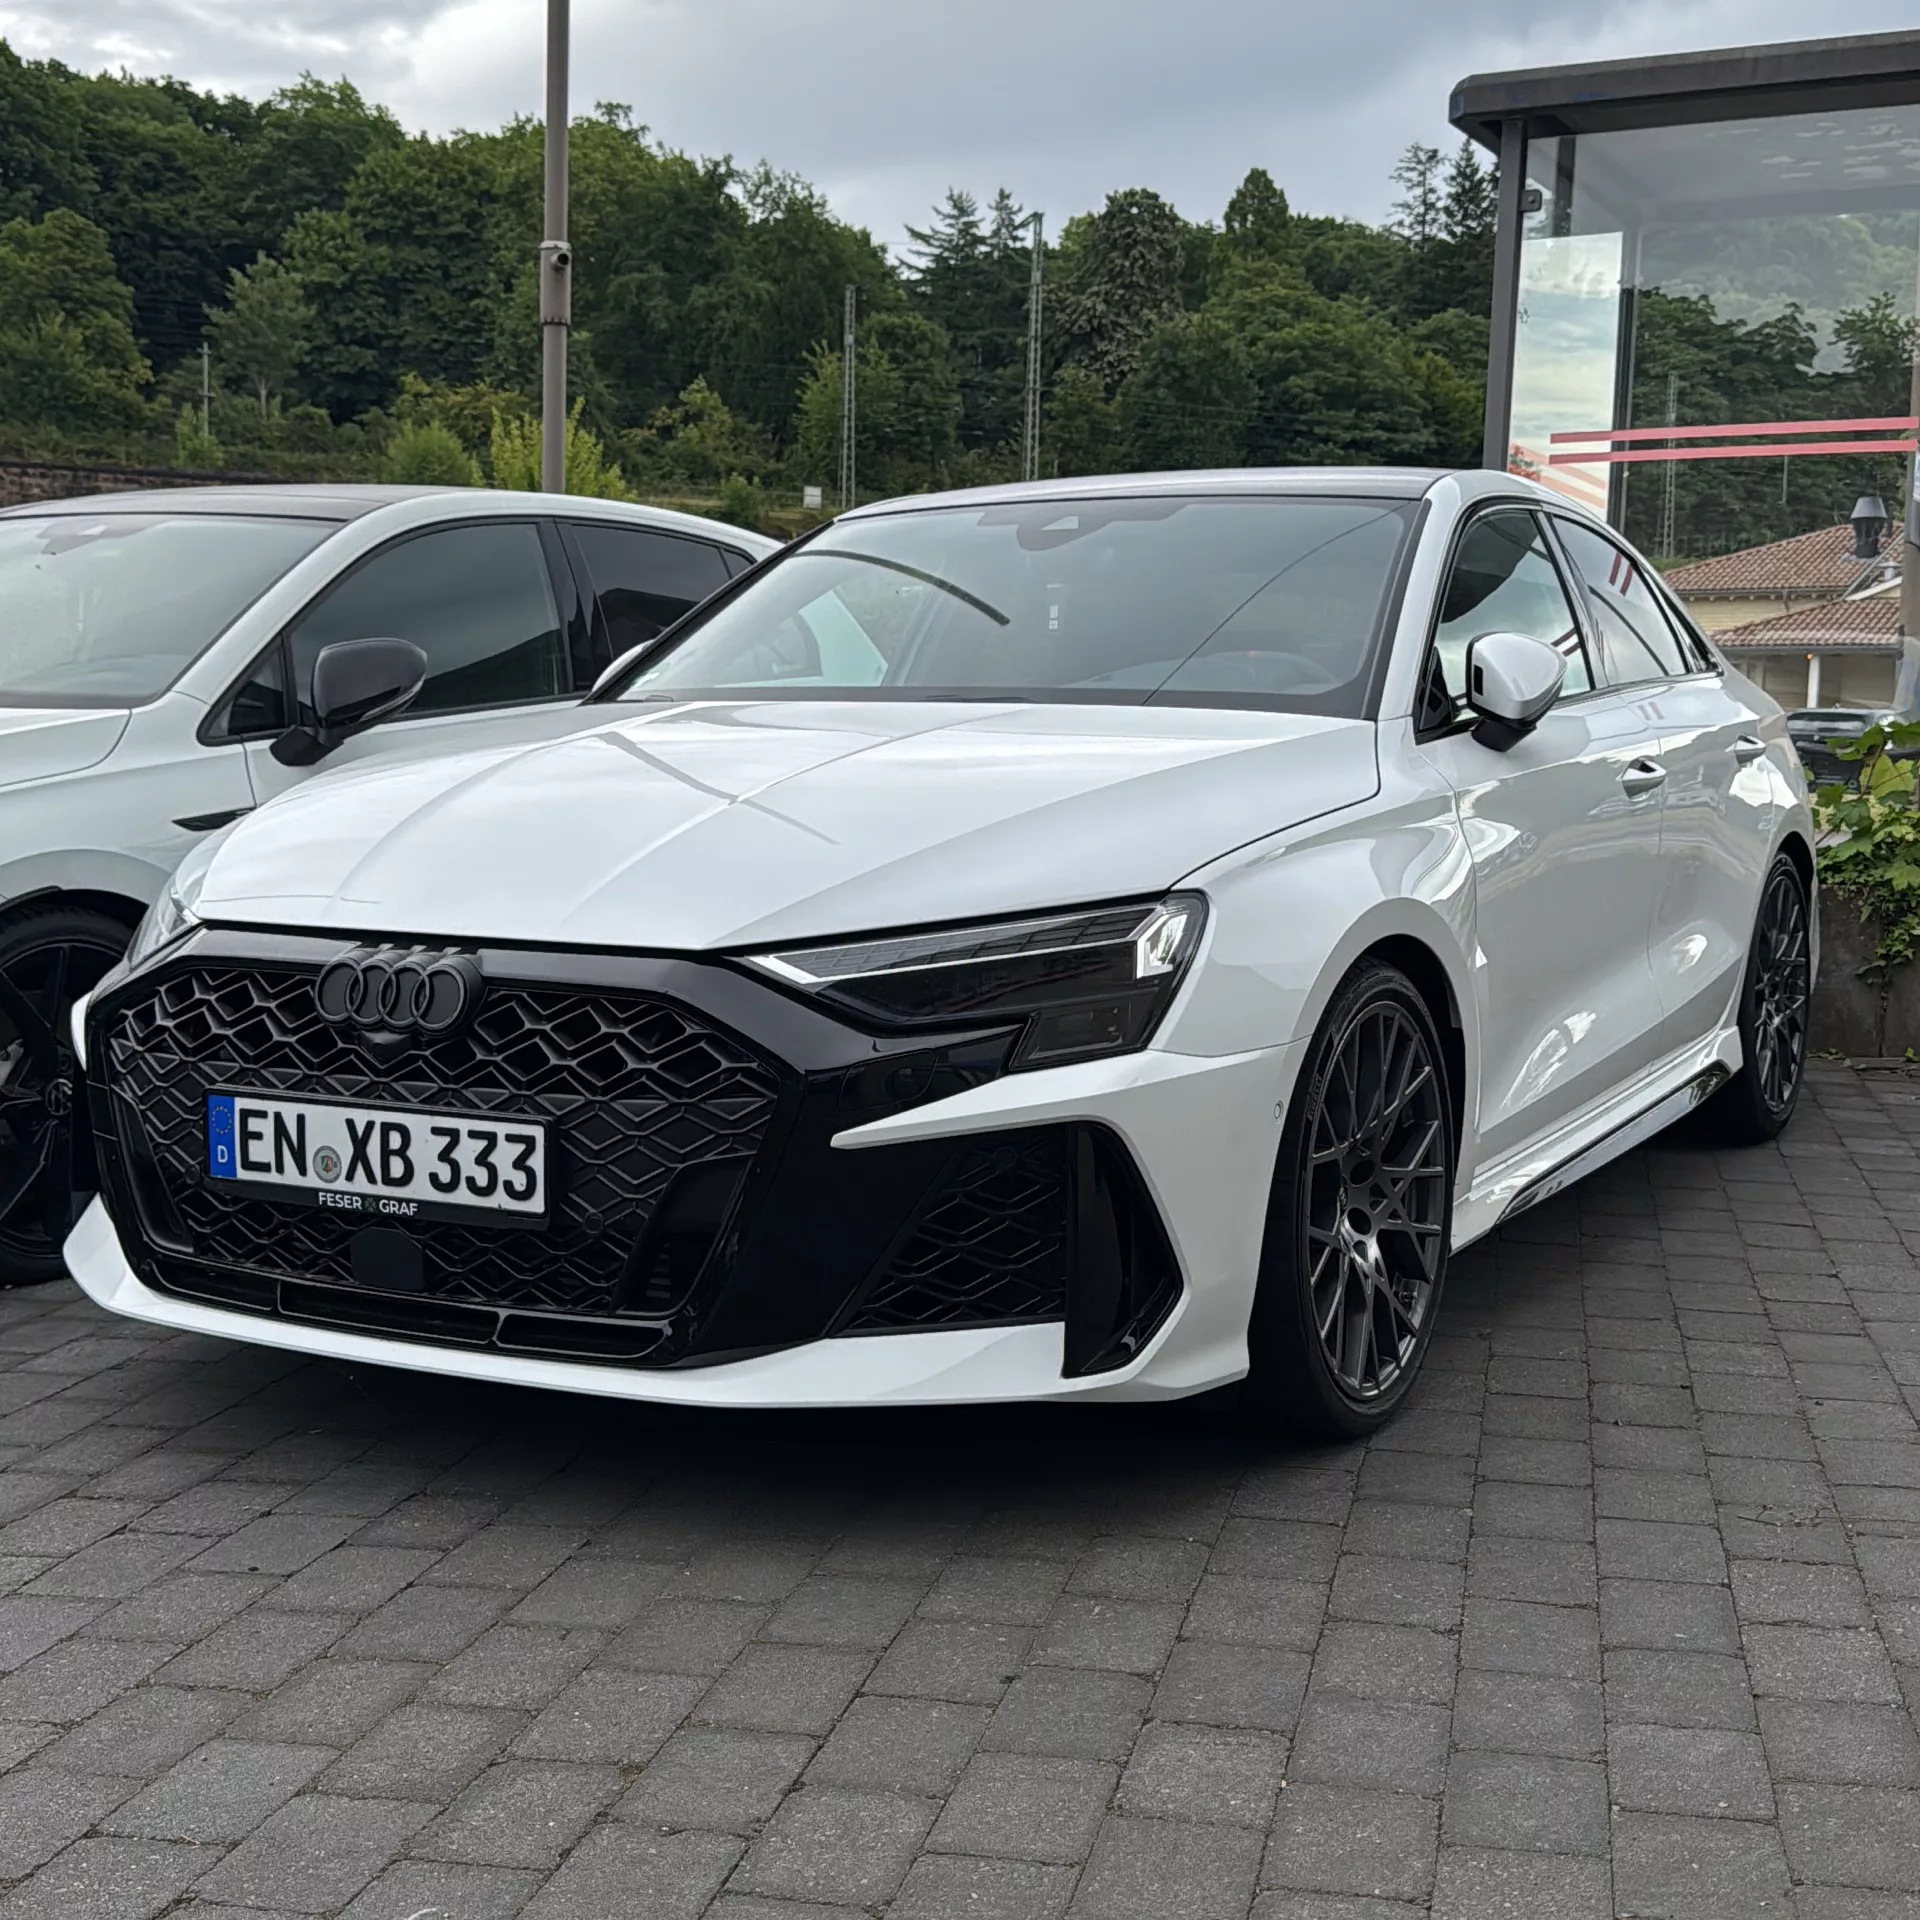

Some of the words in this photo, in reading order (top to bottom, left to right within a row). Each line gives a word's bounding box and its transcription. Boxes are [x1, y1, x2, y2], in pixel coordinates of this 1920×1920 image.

[217, 1145, 228, 1163] D
[238, 1107, 307, 1177] EN
[345, 1117, 414, 1187] XB
[429, 1125, 537, 1201] 333
[318, 1191, 362, 1211] FESER
[379, 1199, 419, 1217] GRAF
